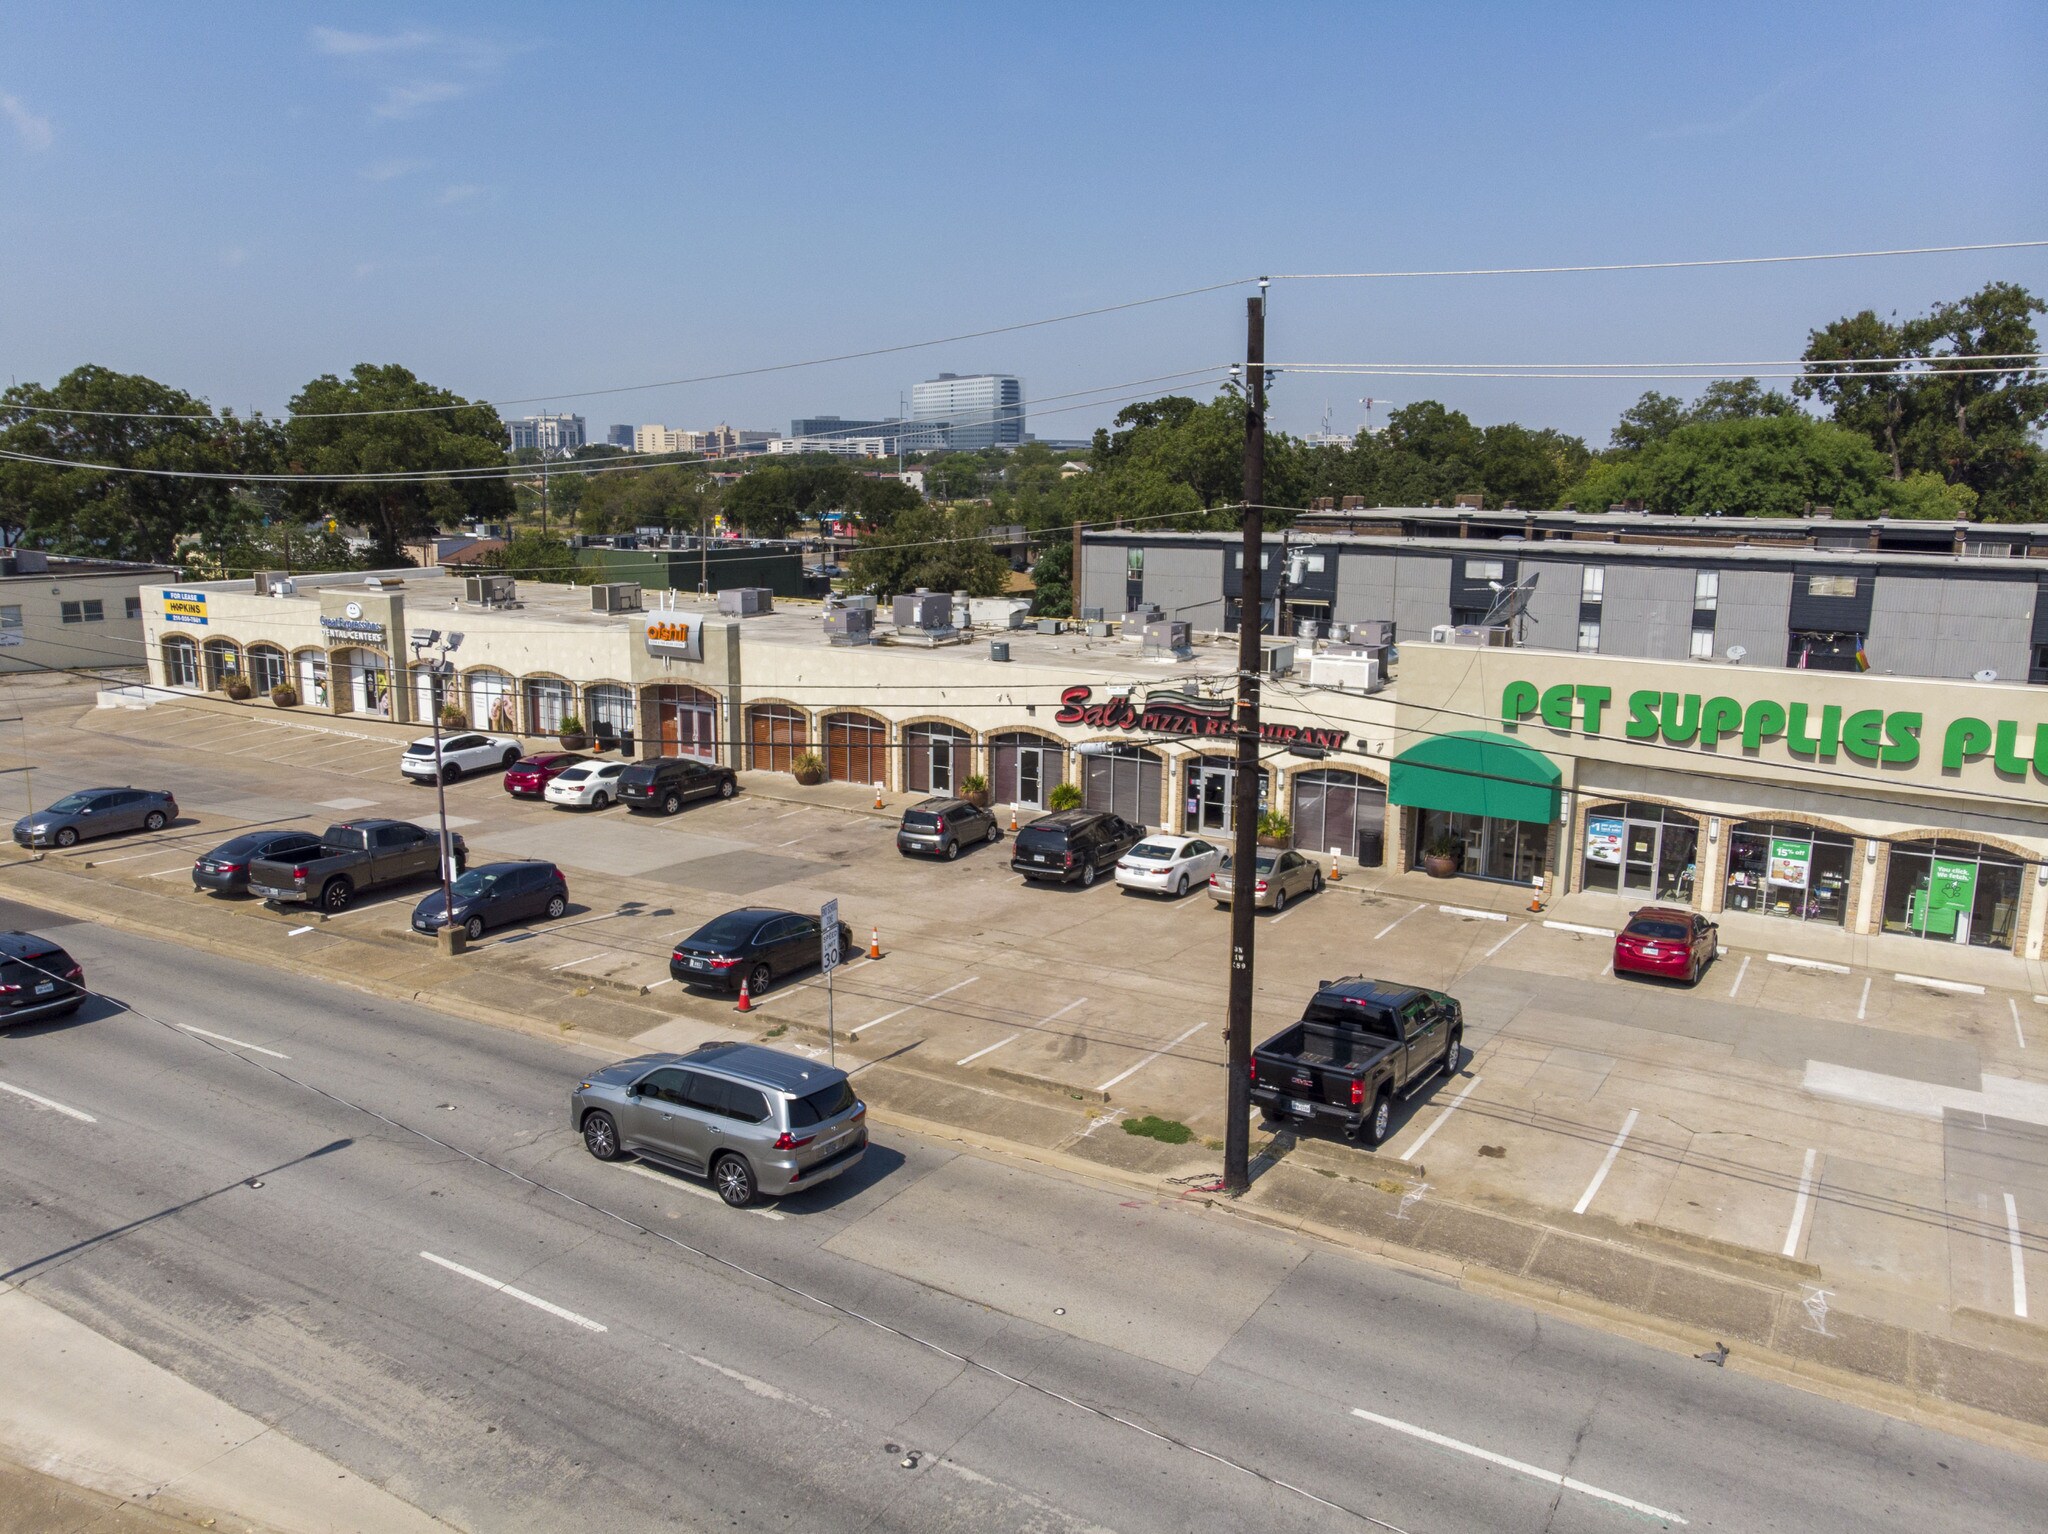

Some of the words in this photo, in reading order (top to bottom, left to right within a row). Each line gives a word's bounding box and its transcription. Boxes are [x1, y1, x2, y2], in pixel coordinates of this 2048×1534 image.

[170, 592, 181, 600] FOR
[181, 594, 198, 602] LEASE
[170, 602, 201, 614] HOPKINS
[321, 628, 350, 639] DENTAL
[349, 630, 383, 642] CENTERS
[1055, 685, 1137, 730] Sal's
[1141, 712, 1198, 735] PIZZA
[1501, 680, 1612, 734] PET
[1625, 690, 1923, 763] SUPPLIES
[1777, 847, 1794, 856] 15%
[823, 930, 838, 943] SPEED
[824, 939, 836, 951] LIMIT
[824, 948, 838, 968] 30
